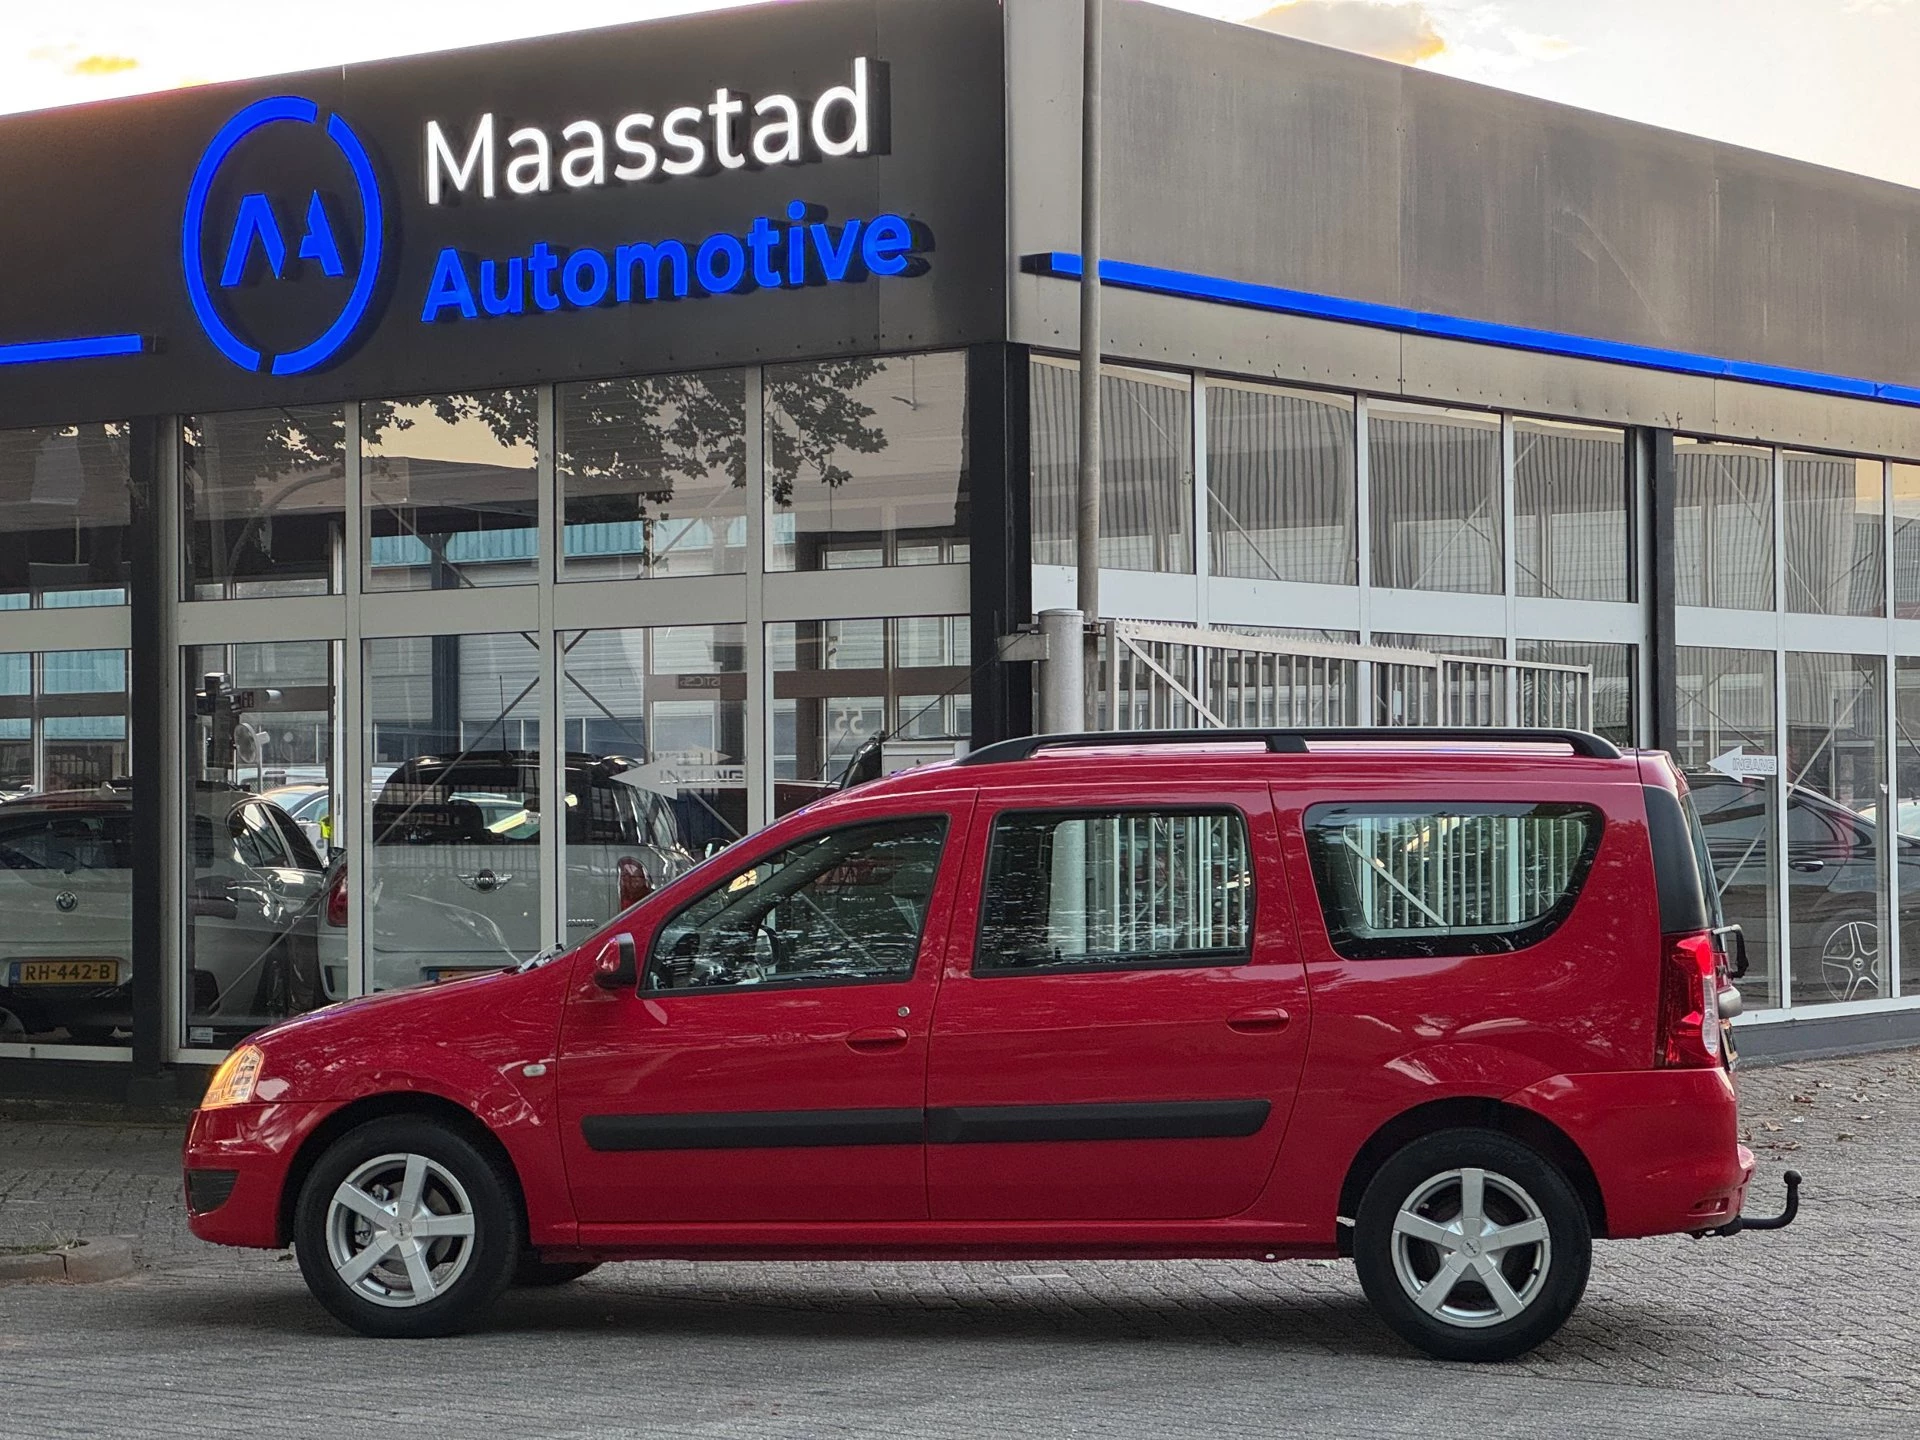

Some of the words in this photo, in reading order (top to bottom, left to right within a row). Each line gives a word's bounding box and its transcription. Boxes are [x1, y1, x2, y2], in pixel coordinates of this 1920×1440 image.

[425, 56, 870, 205] Maasstad
[421, 199, 912, 322] Automotive
[1732, 757, 1775, 772] INGANG
[25, 964, 111, 981] RH-442-B
